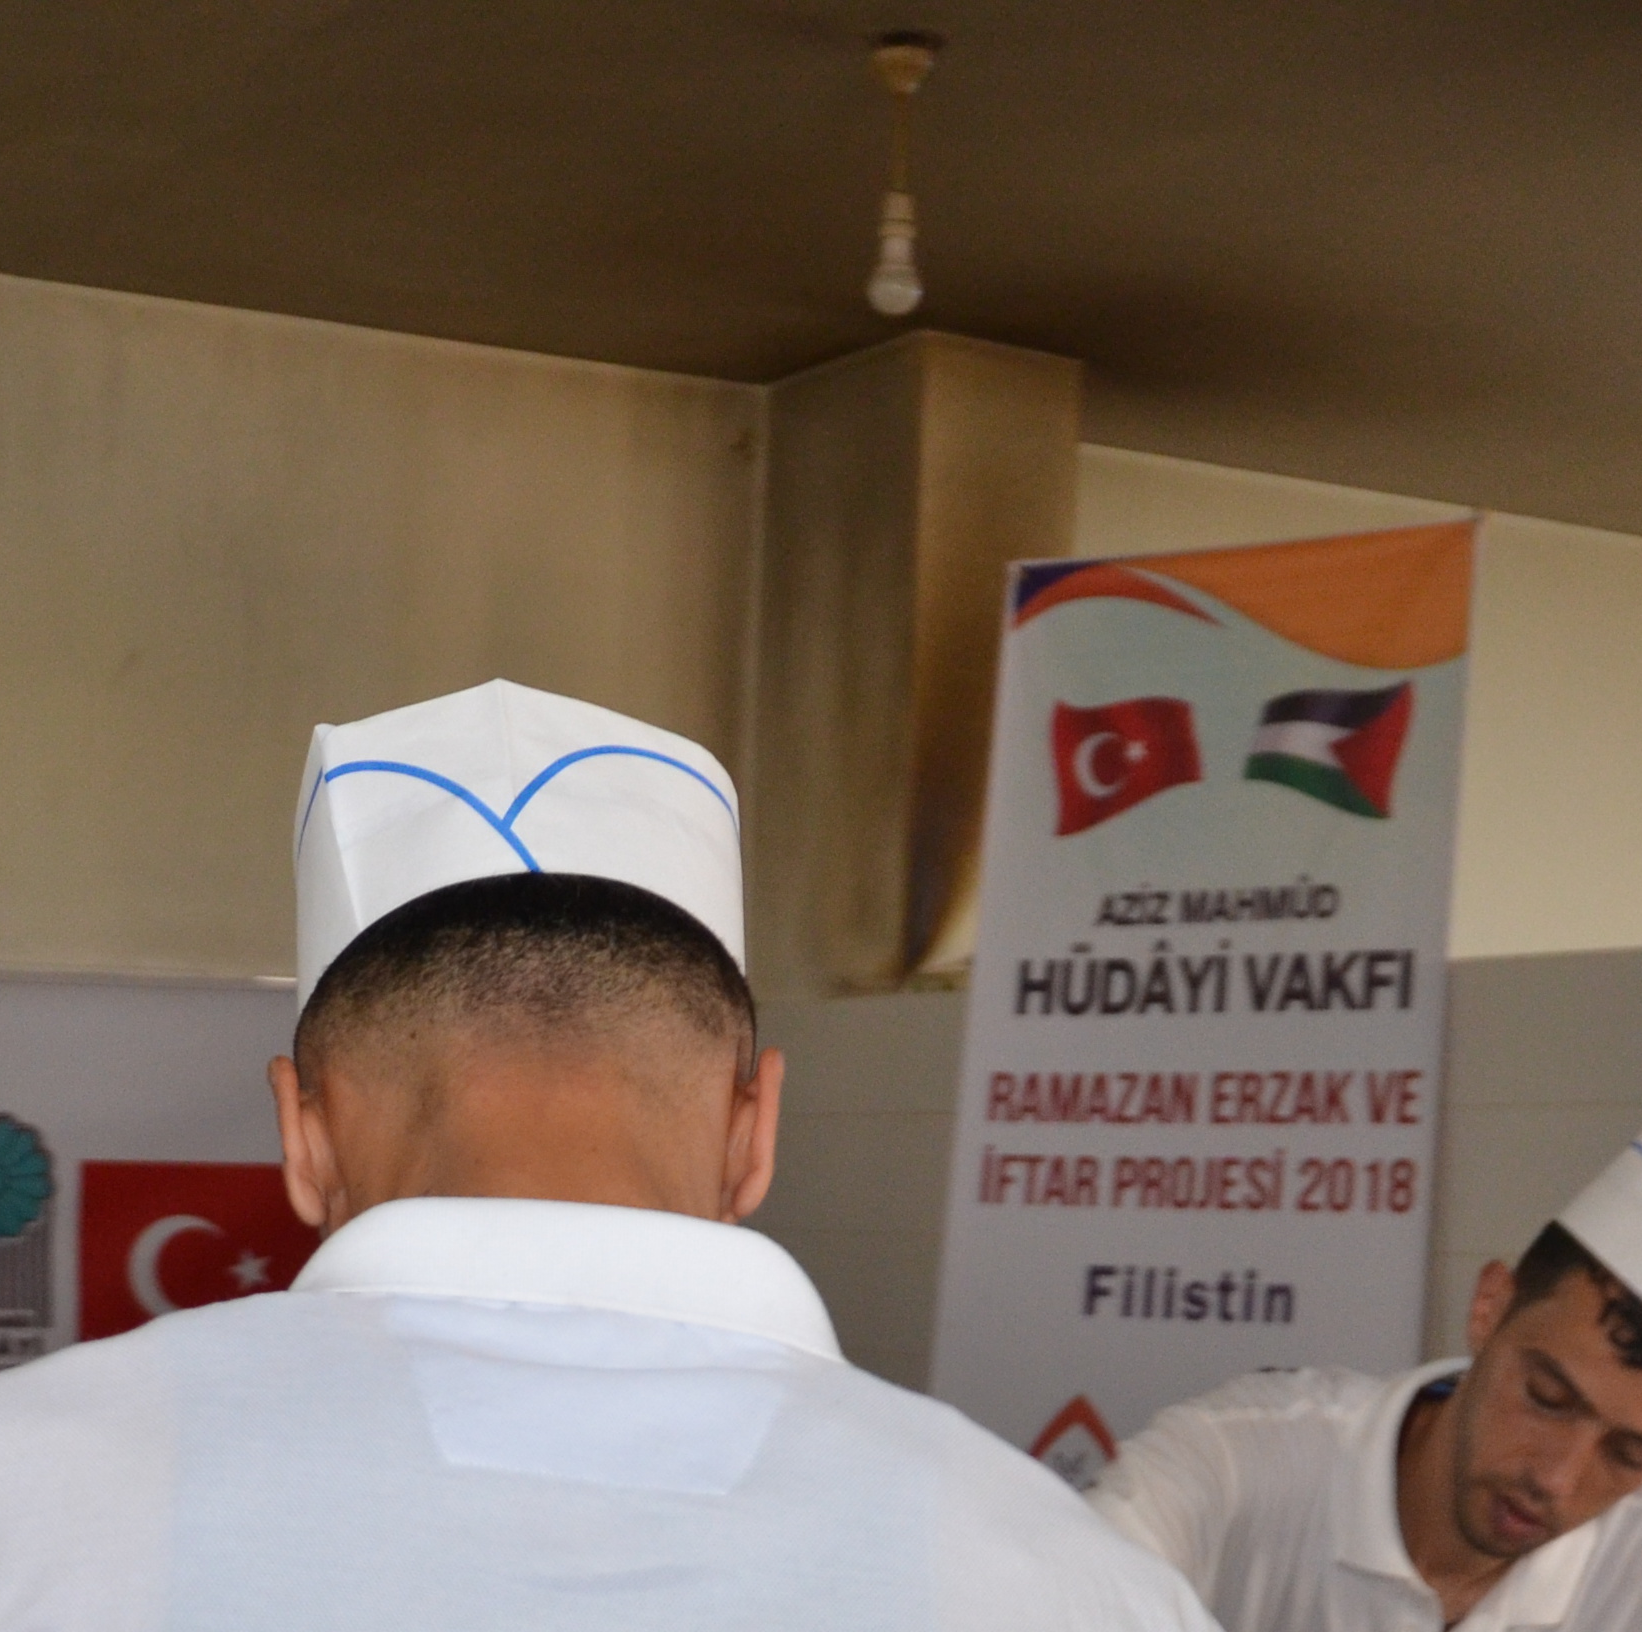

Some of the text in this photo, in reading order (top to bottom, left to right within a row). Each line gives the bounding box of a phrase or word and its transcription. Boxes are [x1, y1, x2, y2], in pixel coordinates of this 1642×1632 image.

[1013, 938, 1417, 1016] HÜDÂYİ VAKFI
[986, 1069, 1424, 1125] RAMAZAN ERZAK VE
[977, 1144, 1417, 1213] İFTAR PROJESİ 2018
[1082, 1265, 1295, 1323] Filistin
